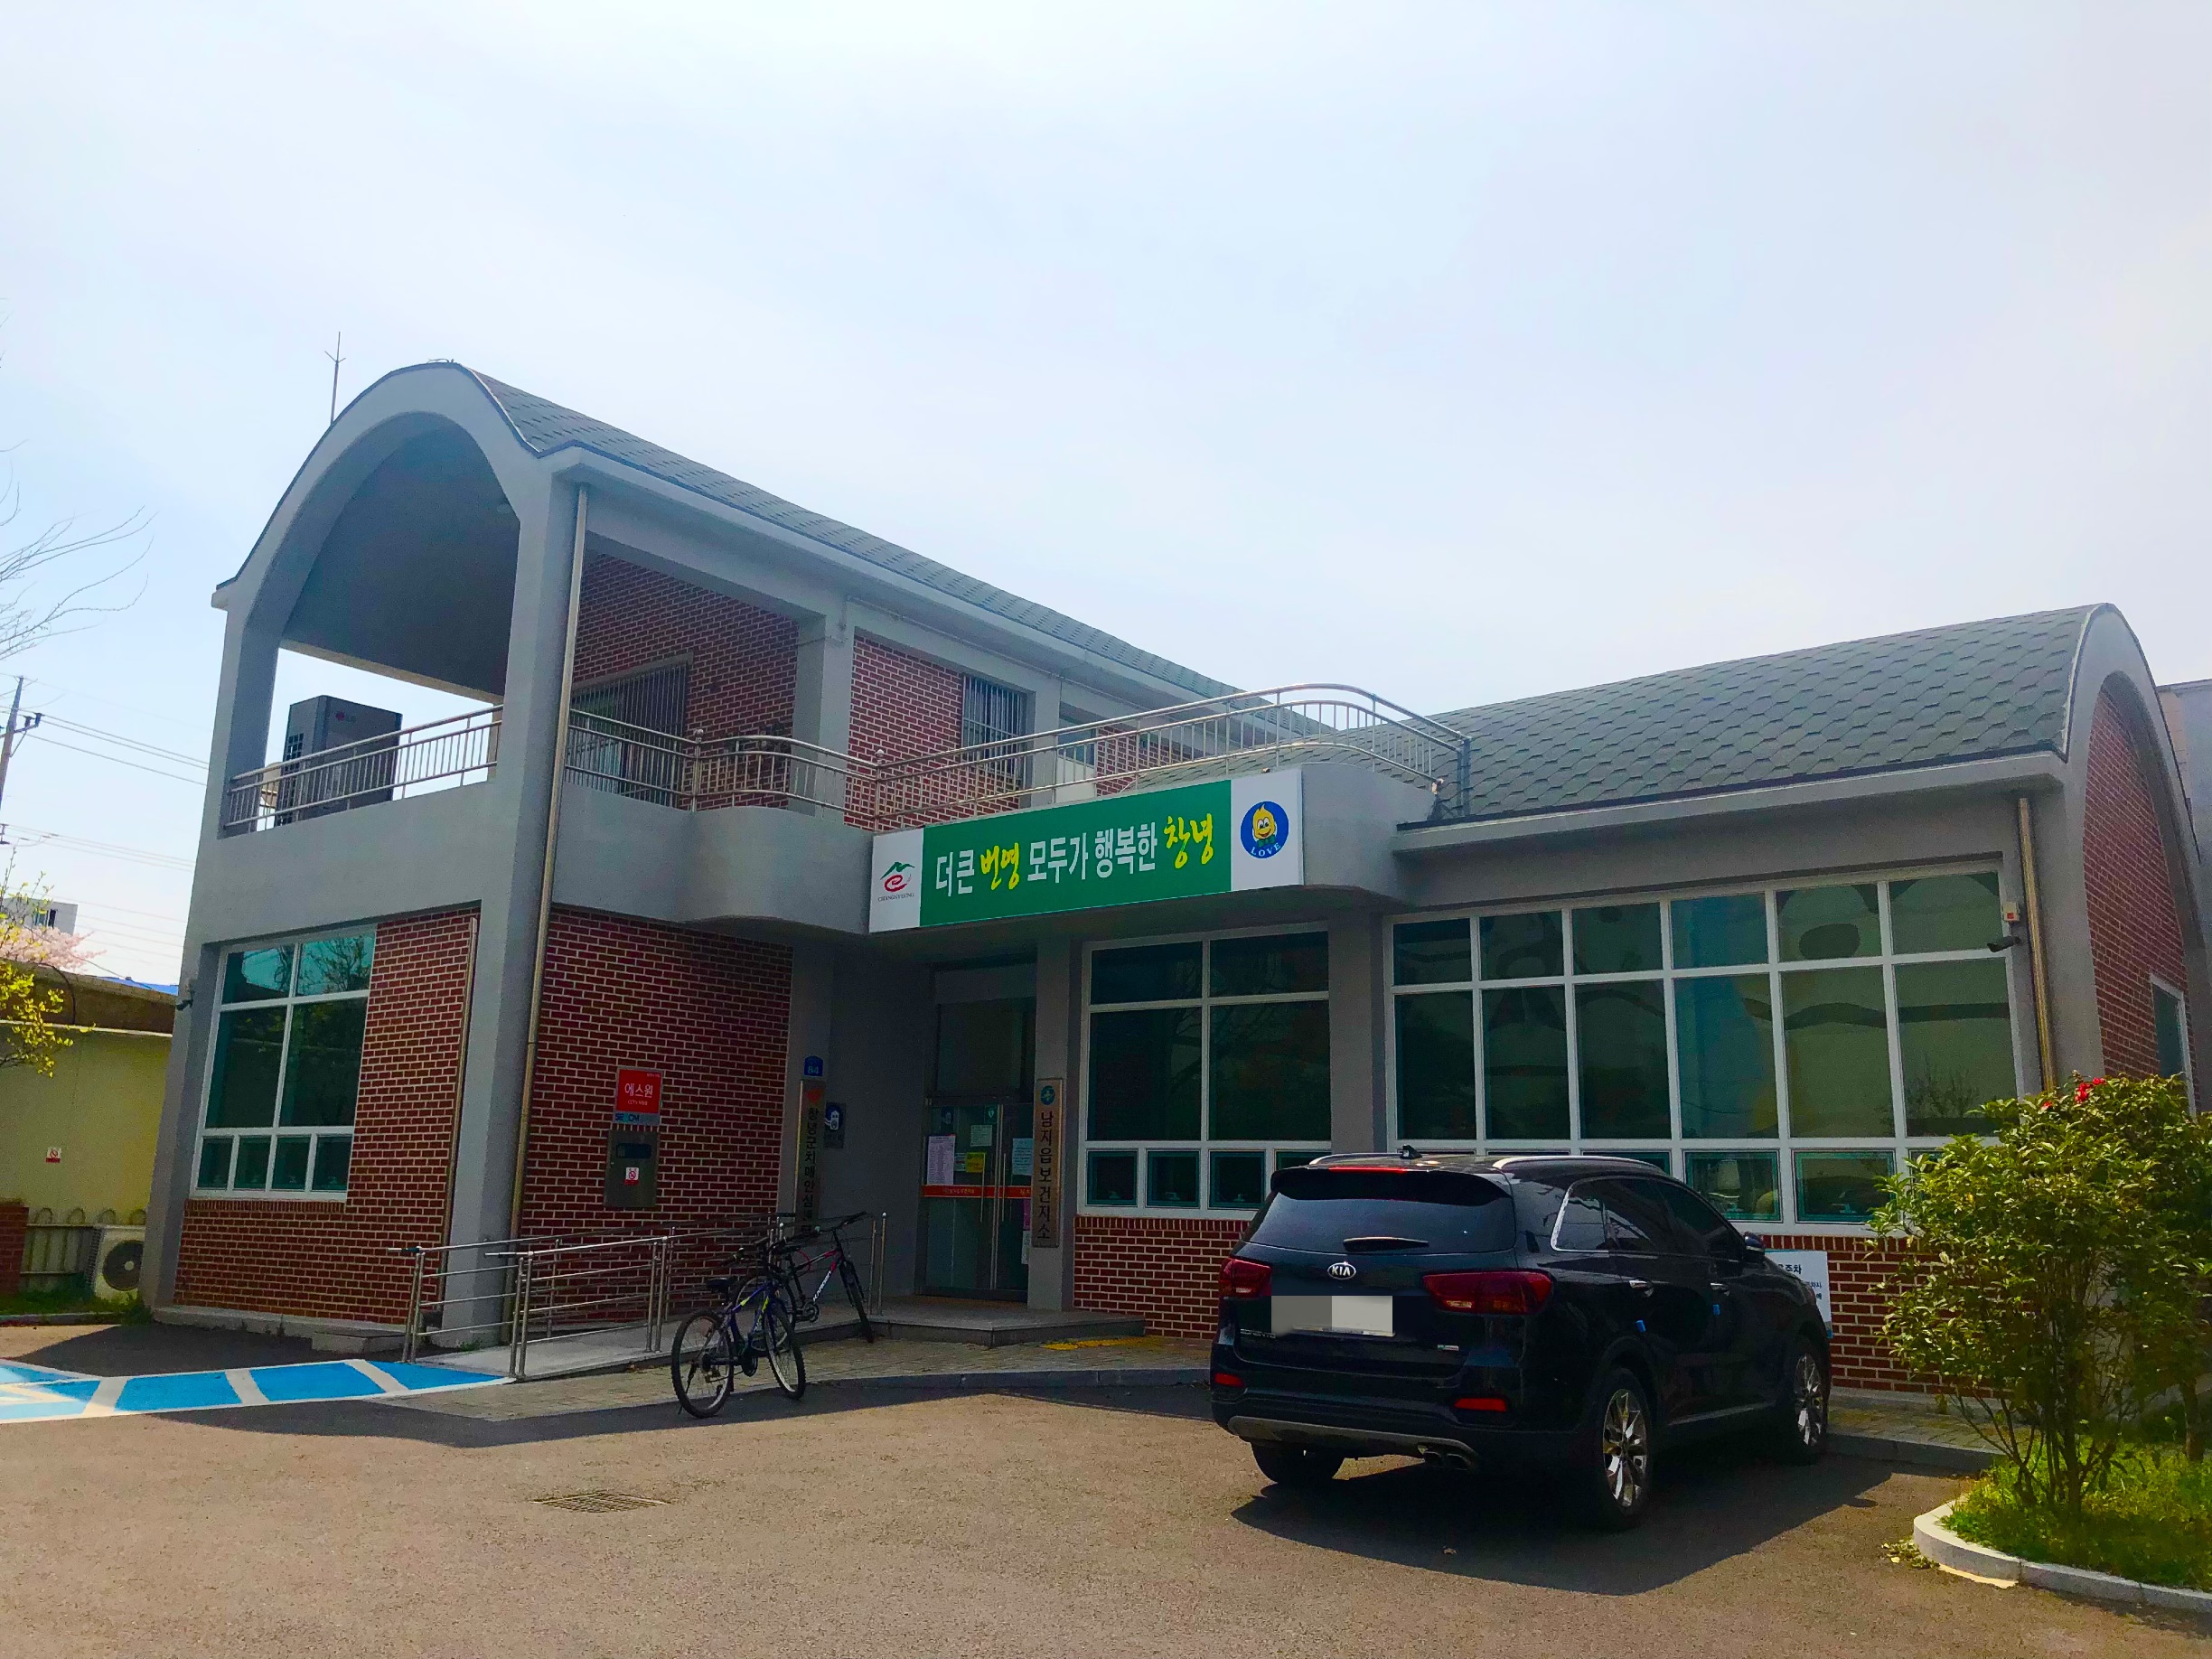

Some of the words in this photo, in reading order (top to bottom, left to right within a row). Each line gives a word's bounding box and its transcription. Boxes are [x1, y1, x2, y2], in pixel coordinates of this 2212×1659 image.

[980, 842, 1020, 891] 번영
[1027, 832, 1089, 884] 모두가
[1095, 821, 1158, 878] 행복한
[1164, 812, 1214, 869] 창녕
[1251, 842, 1281, 857] LOVE
[624, 1083, 653, 1099] 에스원
[1037, 1111, 1054, 1240] 남지읍보건지소
[1331, 1265, 1351, 1277] KIA
